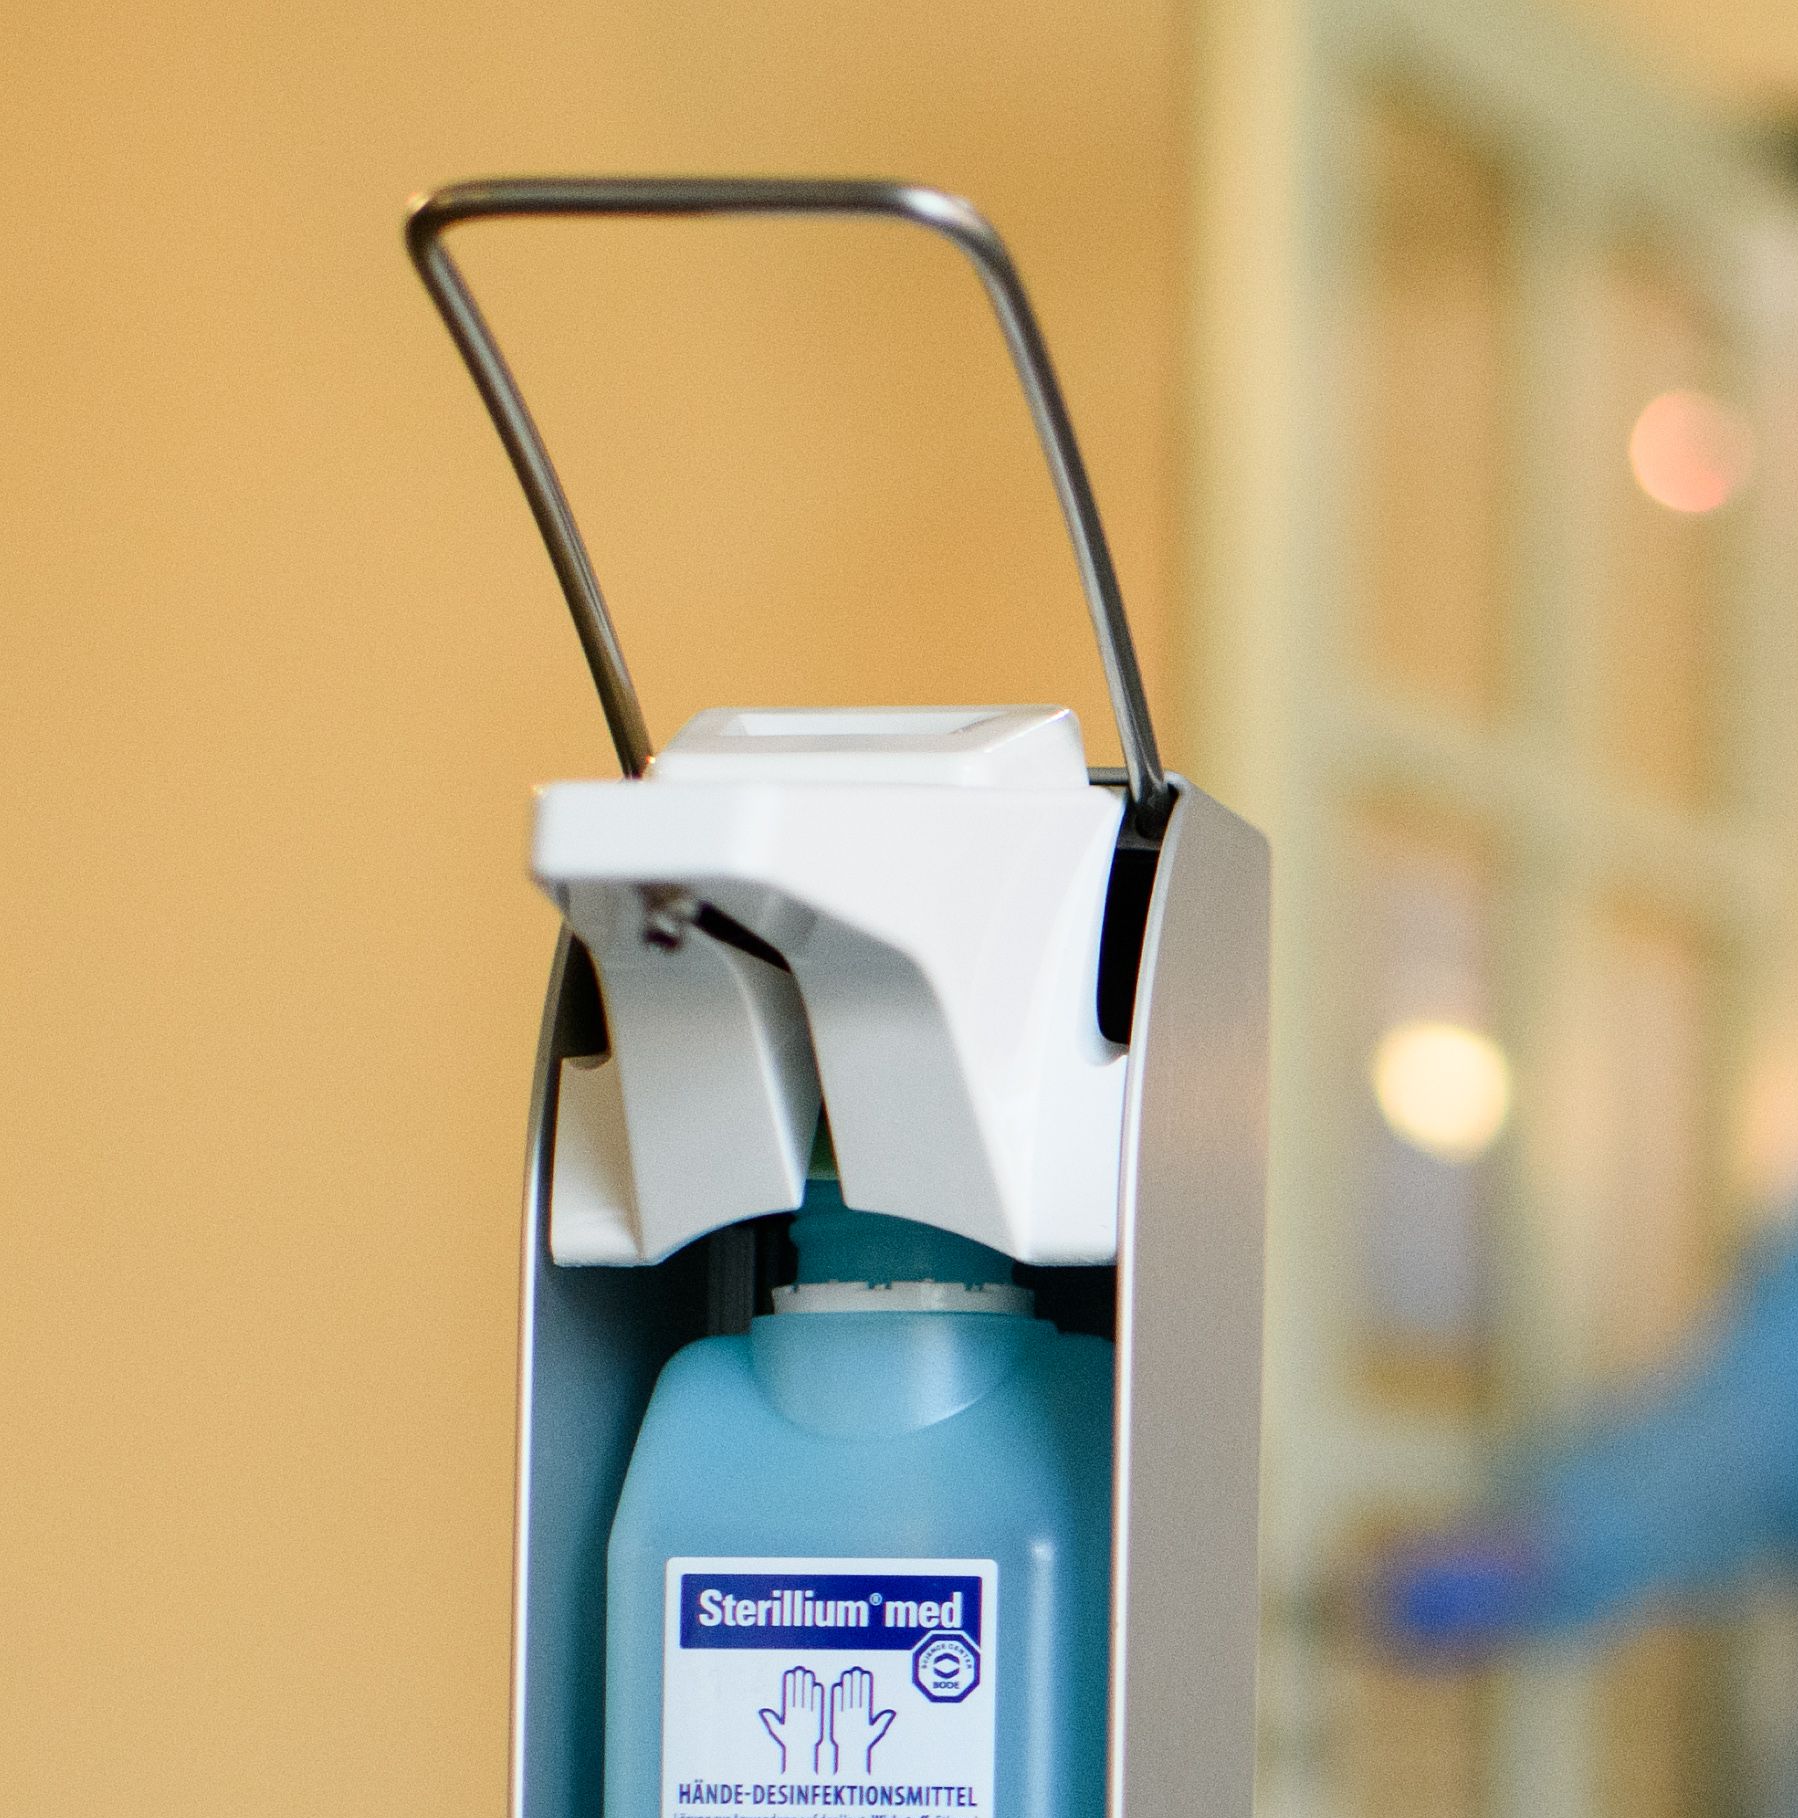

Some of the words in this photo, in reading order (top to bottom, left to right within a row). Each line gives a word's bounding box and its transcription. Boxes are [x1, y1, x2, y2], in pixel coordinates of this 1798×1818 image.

[885, 1591, 963, 1629] med
[933, 1681, 960, 1690] BODE
[678, 1779, 978, 1807] HÄNDE-DESINFEKTIONSMITTEL
